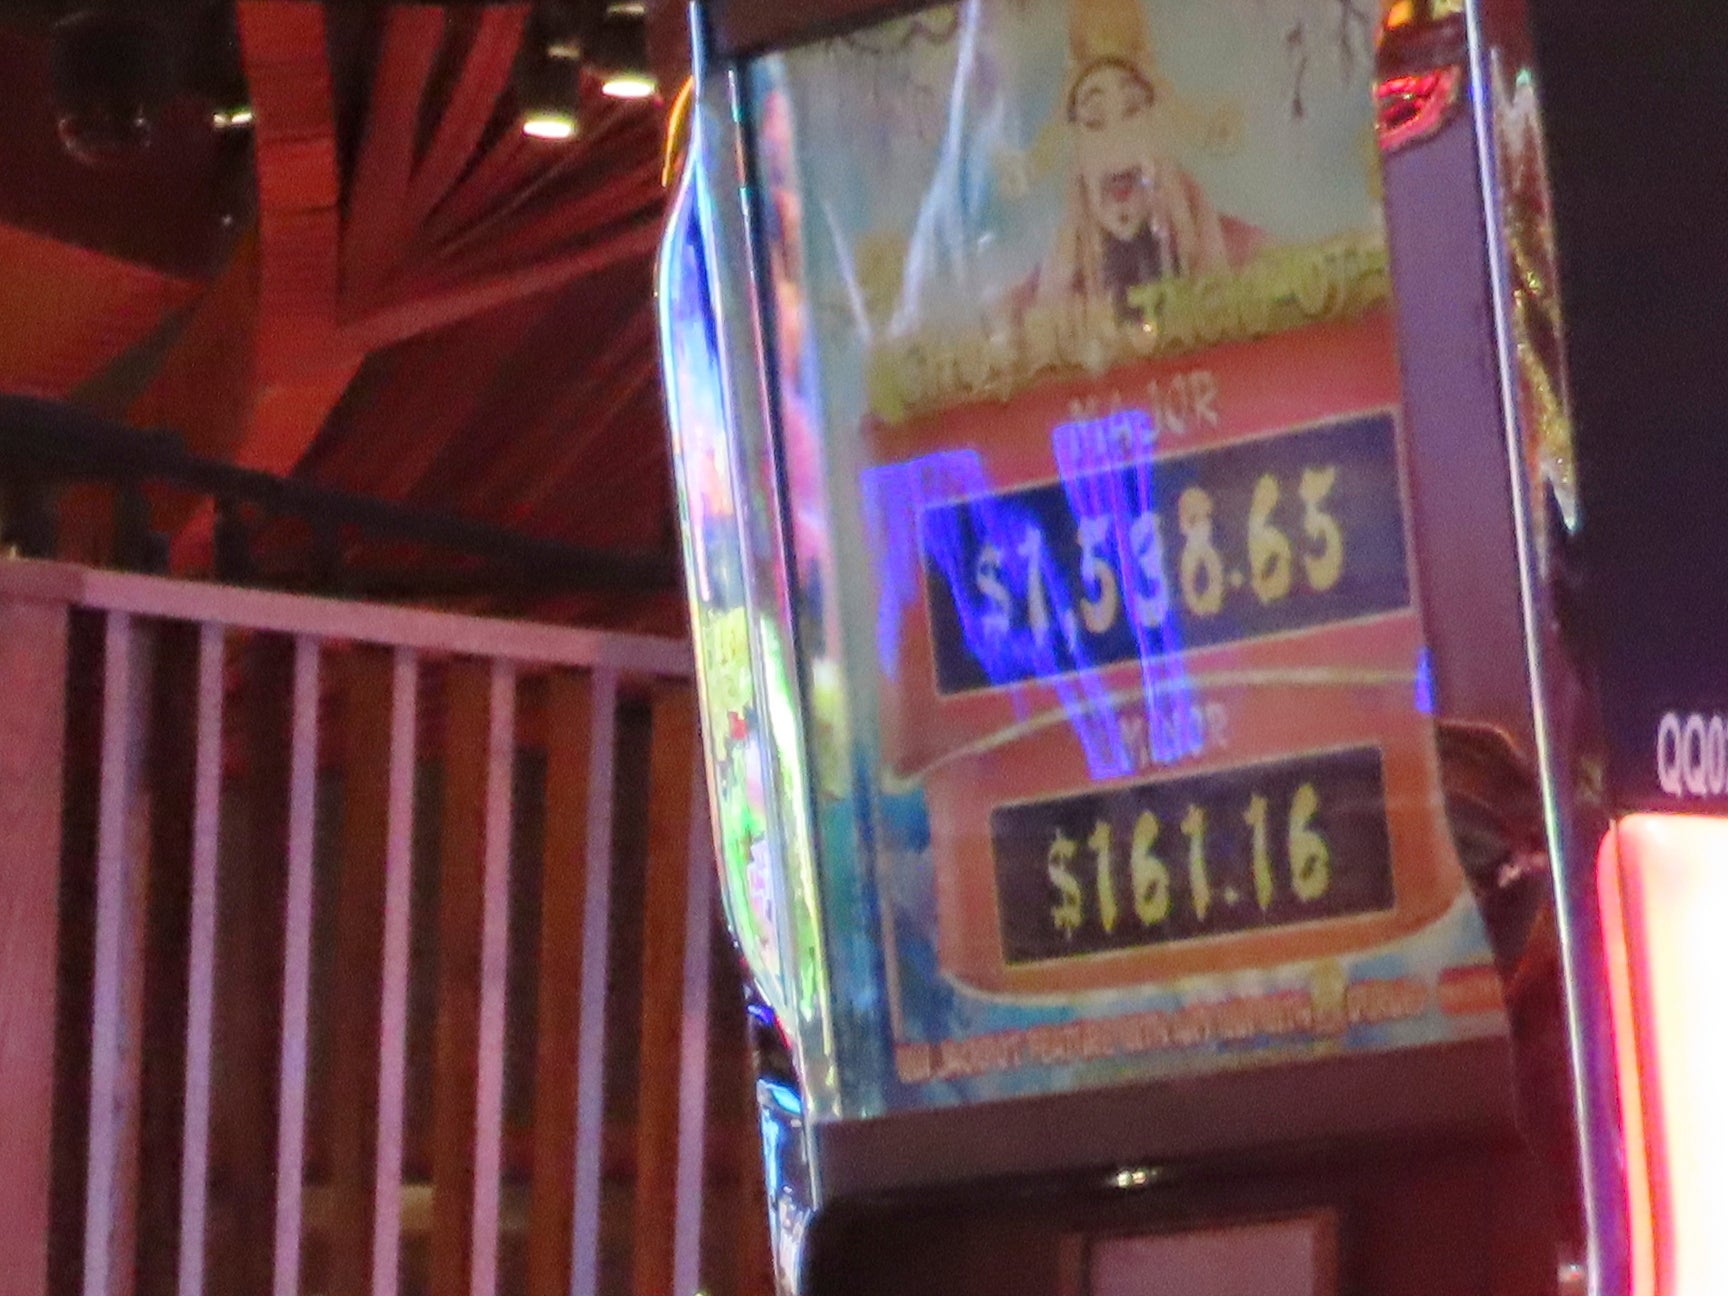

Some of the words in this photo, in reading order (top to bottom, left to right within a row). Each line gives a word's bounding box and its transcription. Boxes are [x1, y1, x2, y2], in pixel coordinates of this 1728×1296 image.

[976, 466, 1342, 652] $1,538.65
[1657, 712, 1728, 797] QQ0
[1047, 783, 1331, 940] $161.16
